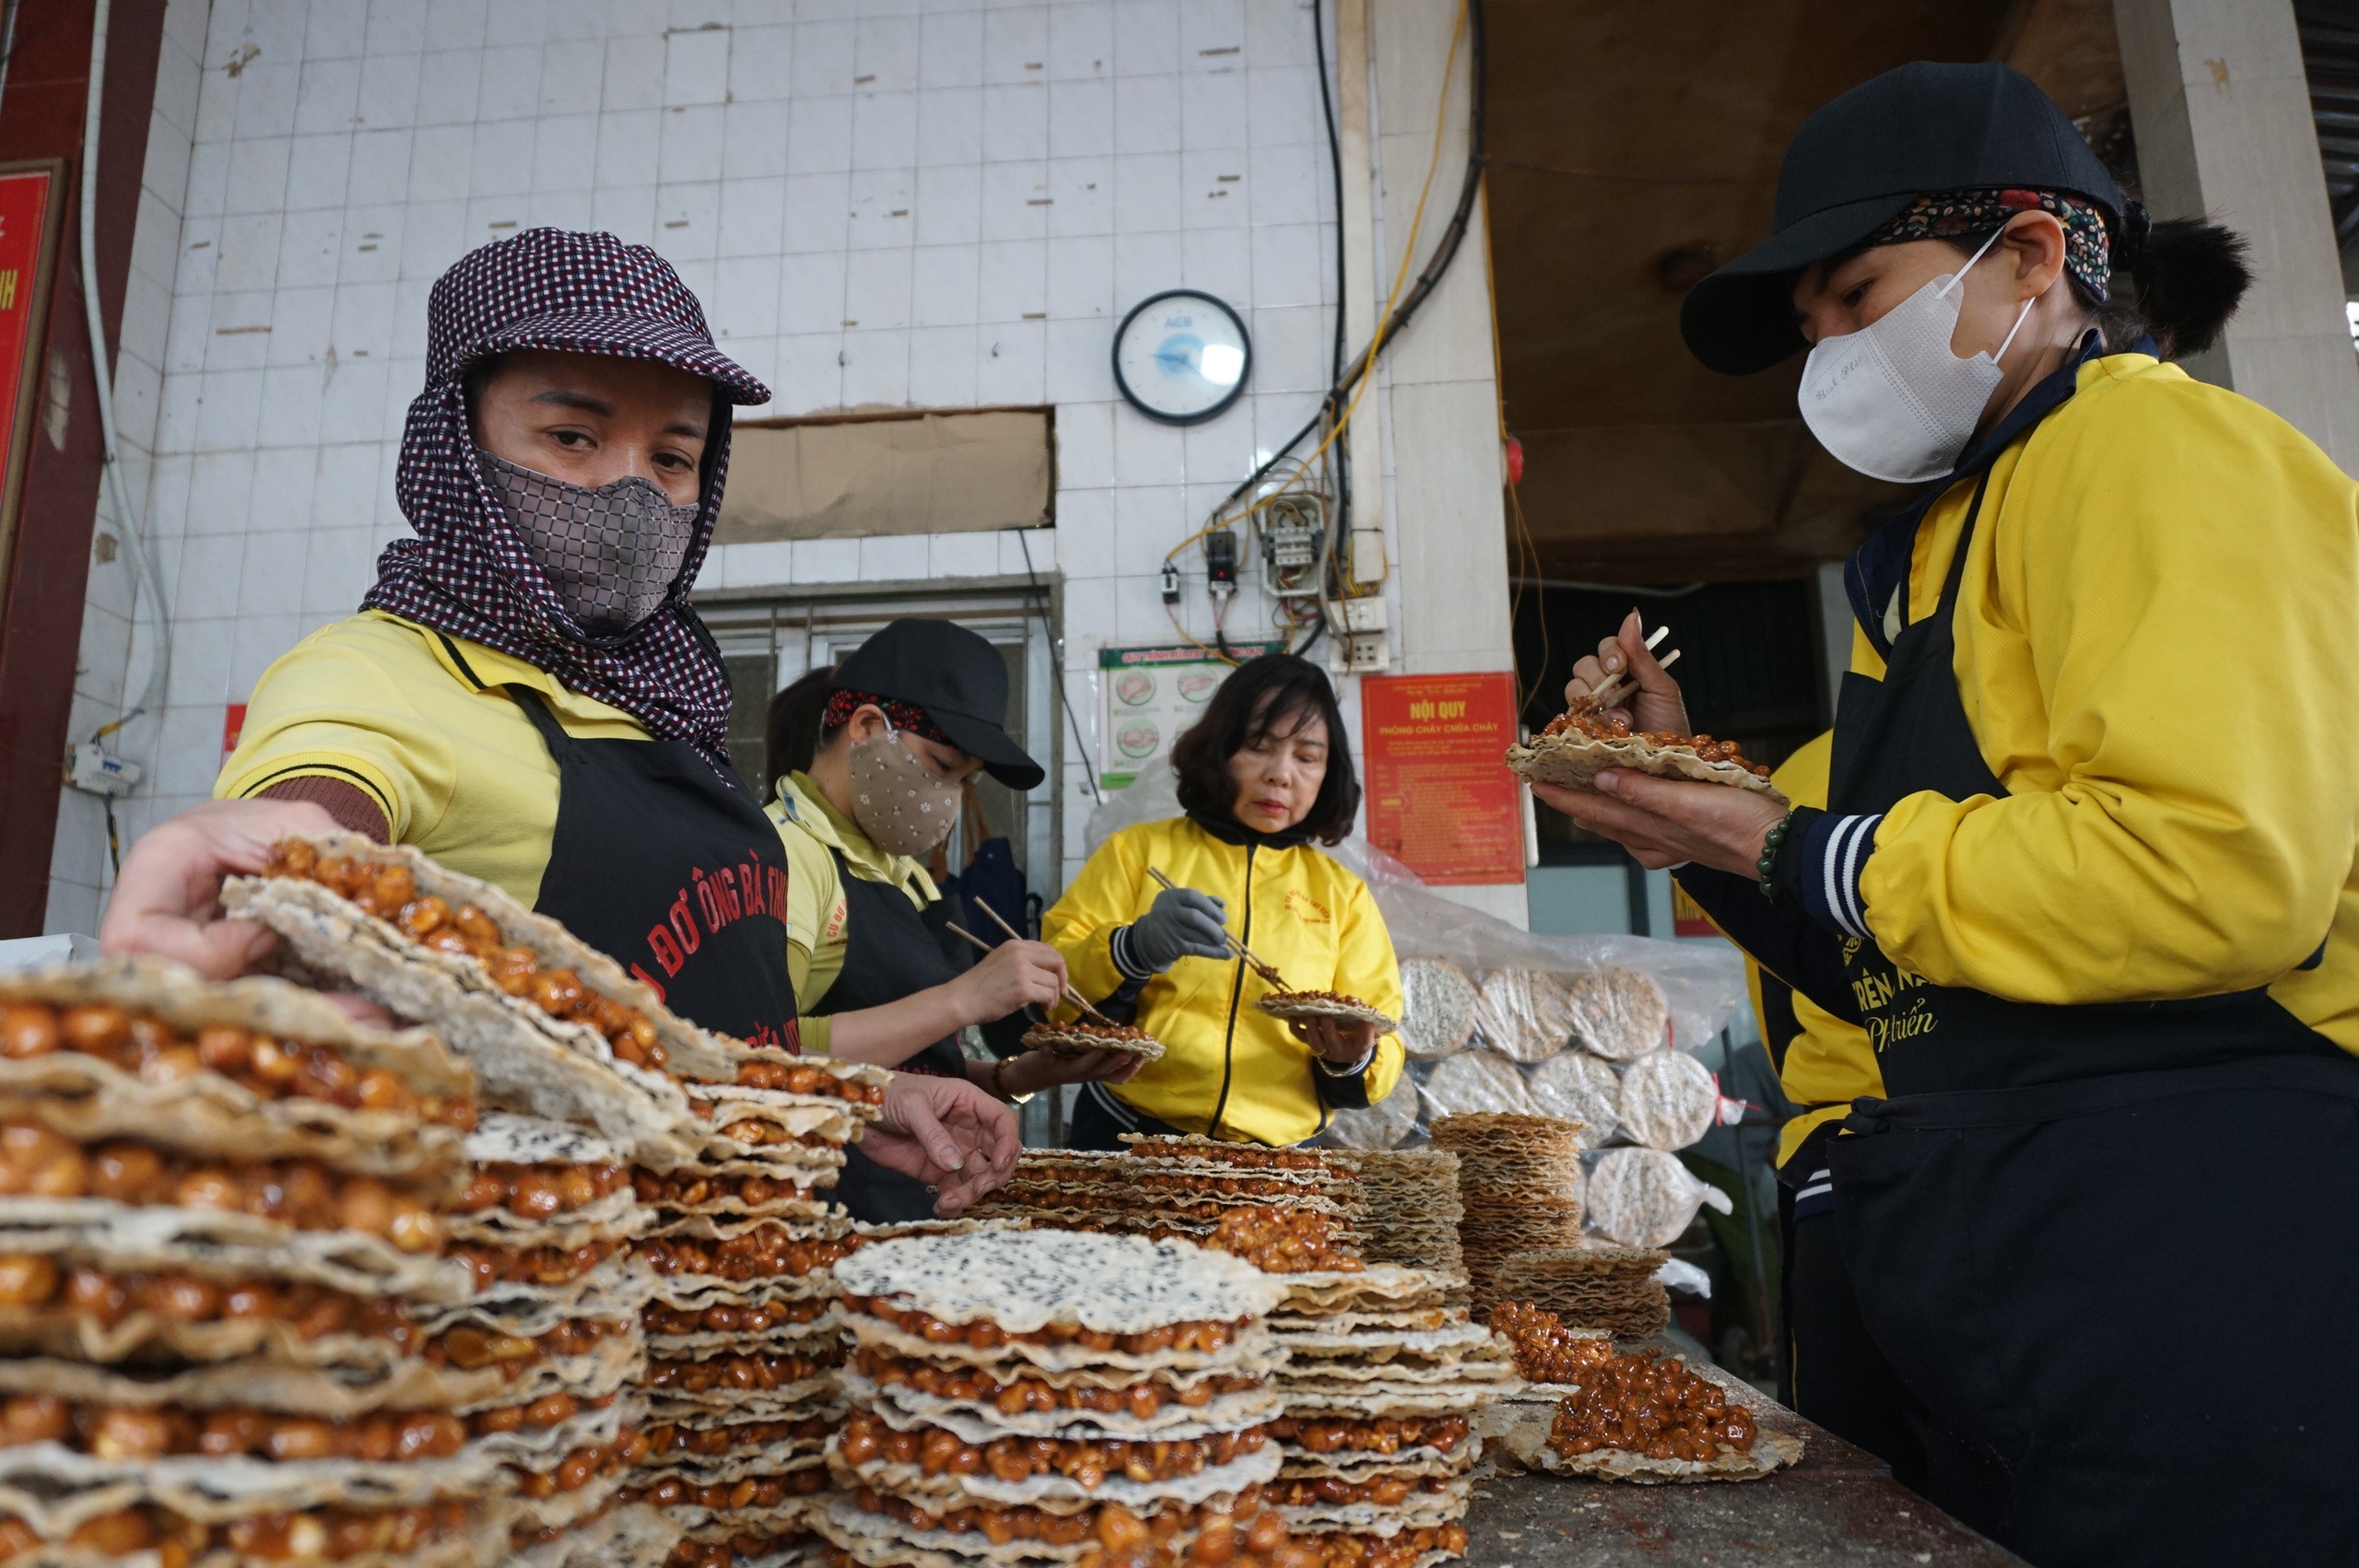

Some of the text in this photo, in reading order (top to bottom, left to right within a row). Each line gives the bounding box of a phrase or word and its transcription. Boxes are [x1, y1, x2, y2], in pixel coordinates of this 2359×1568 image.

[1410, 698, 1466, 722] NỘI QUY
[692, 866, 741, 934] ÔNG
[738, 848, 766, 917] BÀ
[1852, 966, 1895, 1012] RÊN
